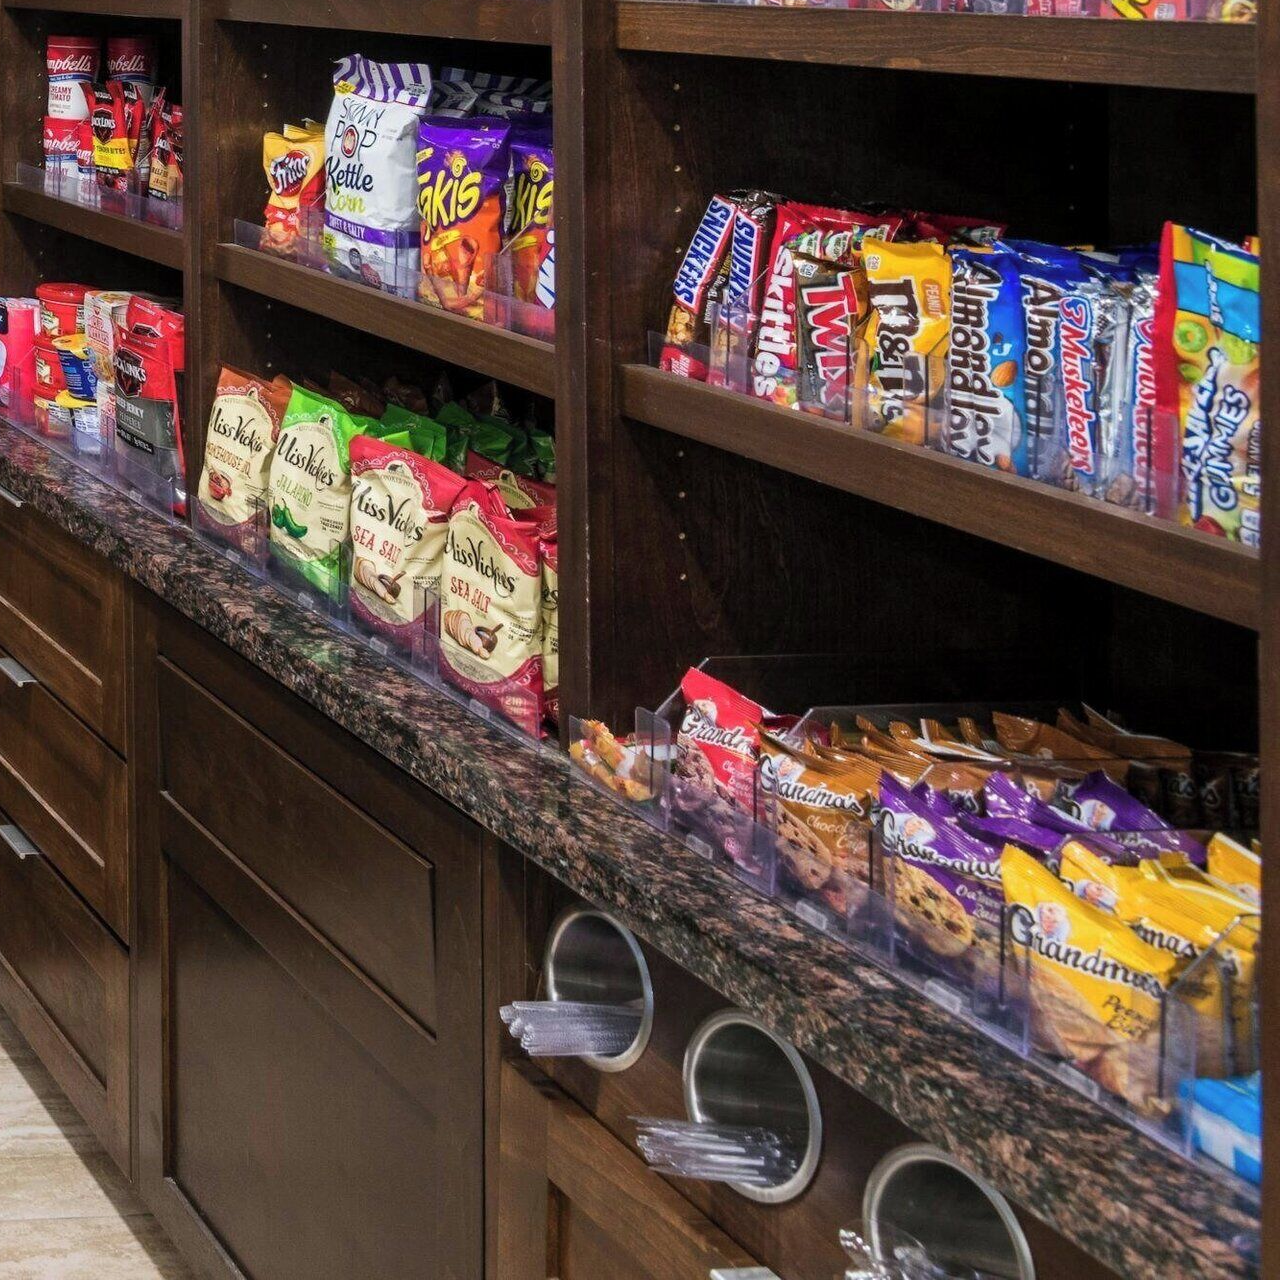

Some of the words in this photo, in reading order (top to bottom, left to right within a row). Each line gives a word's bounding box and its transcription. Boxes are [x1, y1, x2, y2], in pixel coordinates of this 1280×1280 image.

[339, 97, 385, 130] SKINNY
[334, 120, 378, 161] POP
[270, 152, 311, 195] Fritos
[325, 155, 375, 196] Kettle
[327, 188, 367, 214] Corn
[673, 198, 732, 305] SNICKERS
[719, 214, 755, 324] SNICKERS
[924, 283, 939, 316] PEANUT
[1060, 297, 1084, 325] 3
[754, 248, 797, 397] Skittles
[802, 272, 858, 407] TWIX
[126, 403, 145, 419] JERKY
[1060, 324, 1094, 472] Musketeers
[277, 432, 306, 467] Miss
[304, 443, 336, 492] Vickie's
[1202, 384, 1251, 512] GUMMIES
[353, 524, 377, 551] SEA
[379, 538, 403, 567] SALT
[450, 576, 472, 602] SEA
[471, 586, 491, 614] SALT
[760, 757, 865, 815] Grandma's
[1009, 901, 1166, 1001] Grandma's
